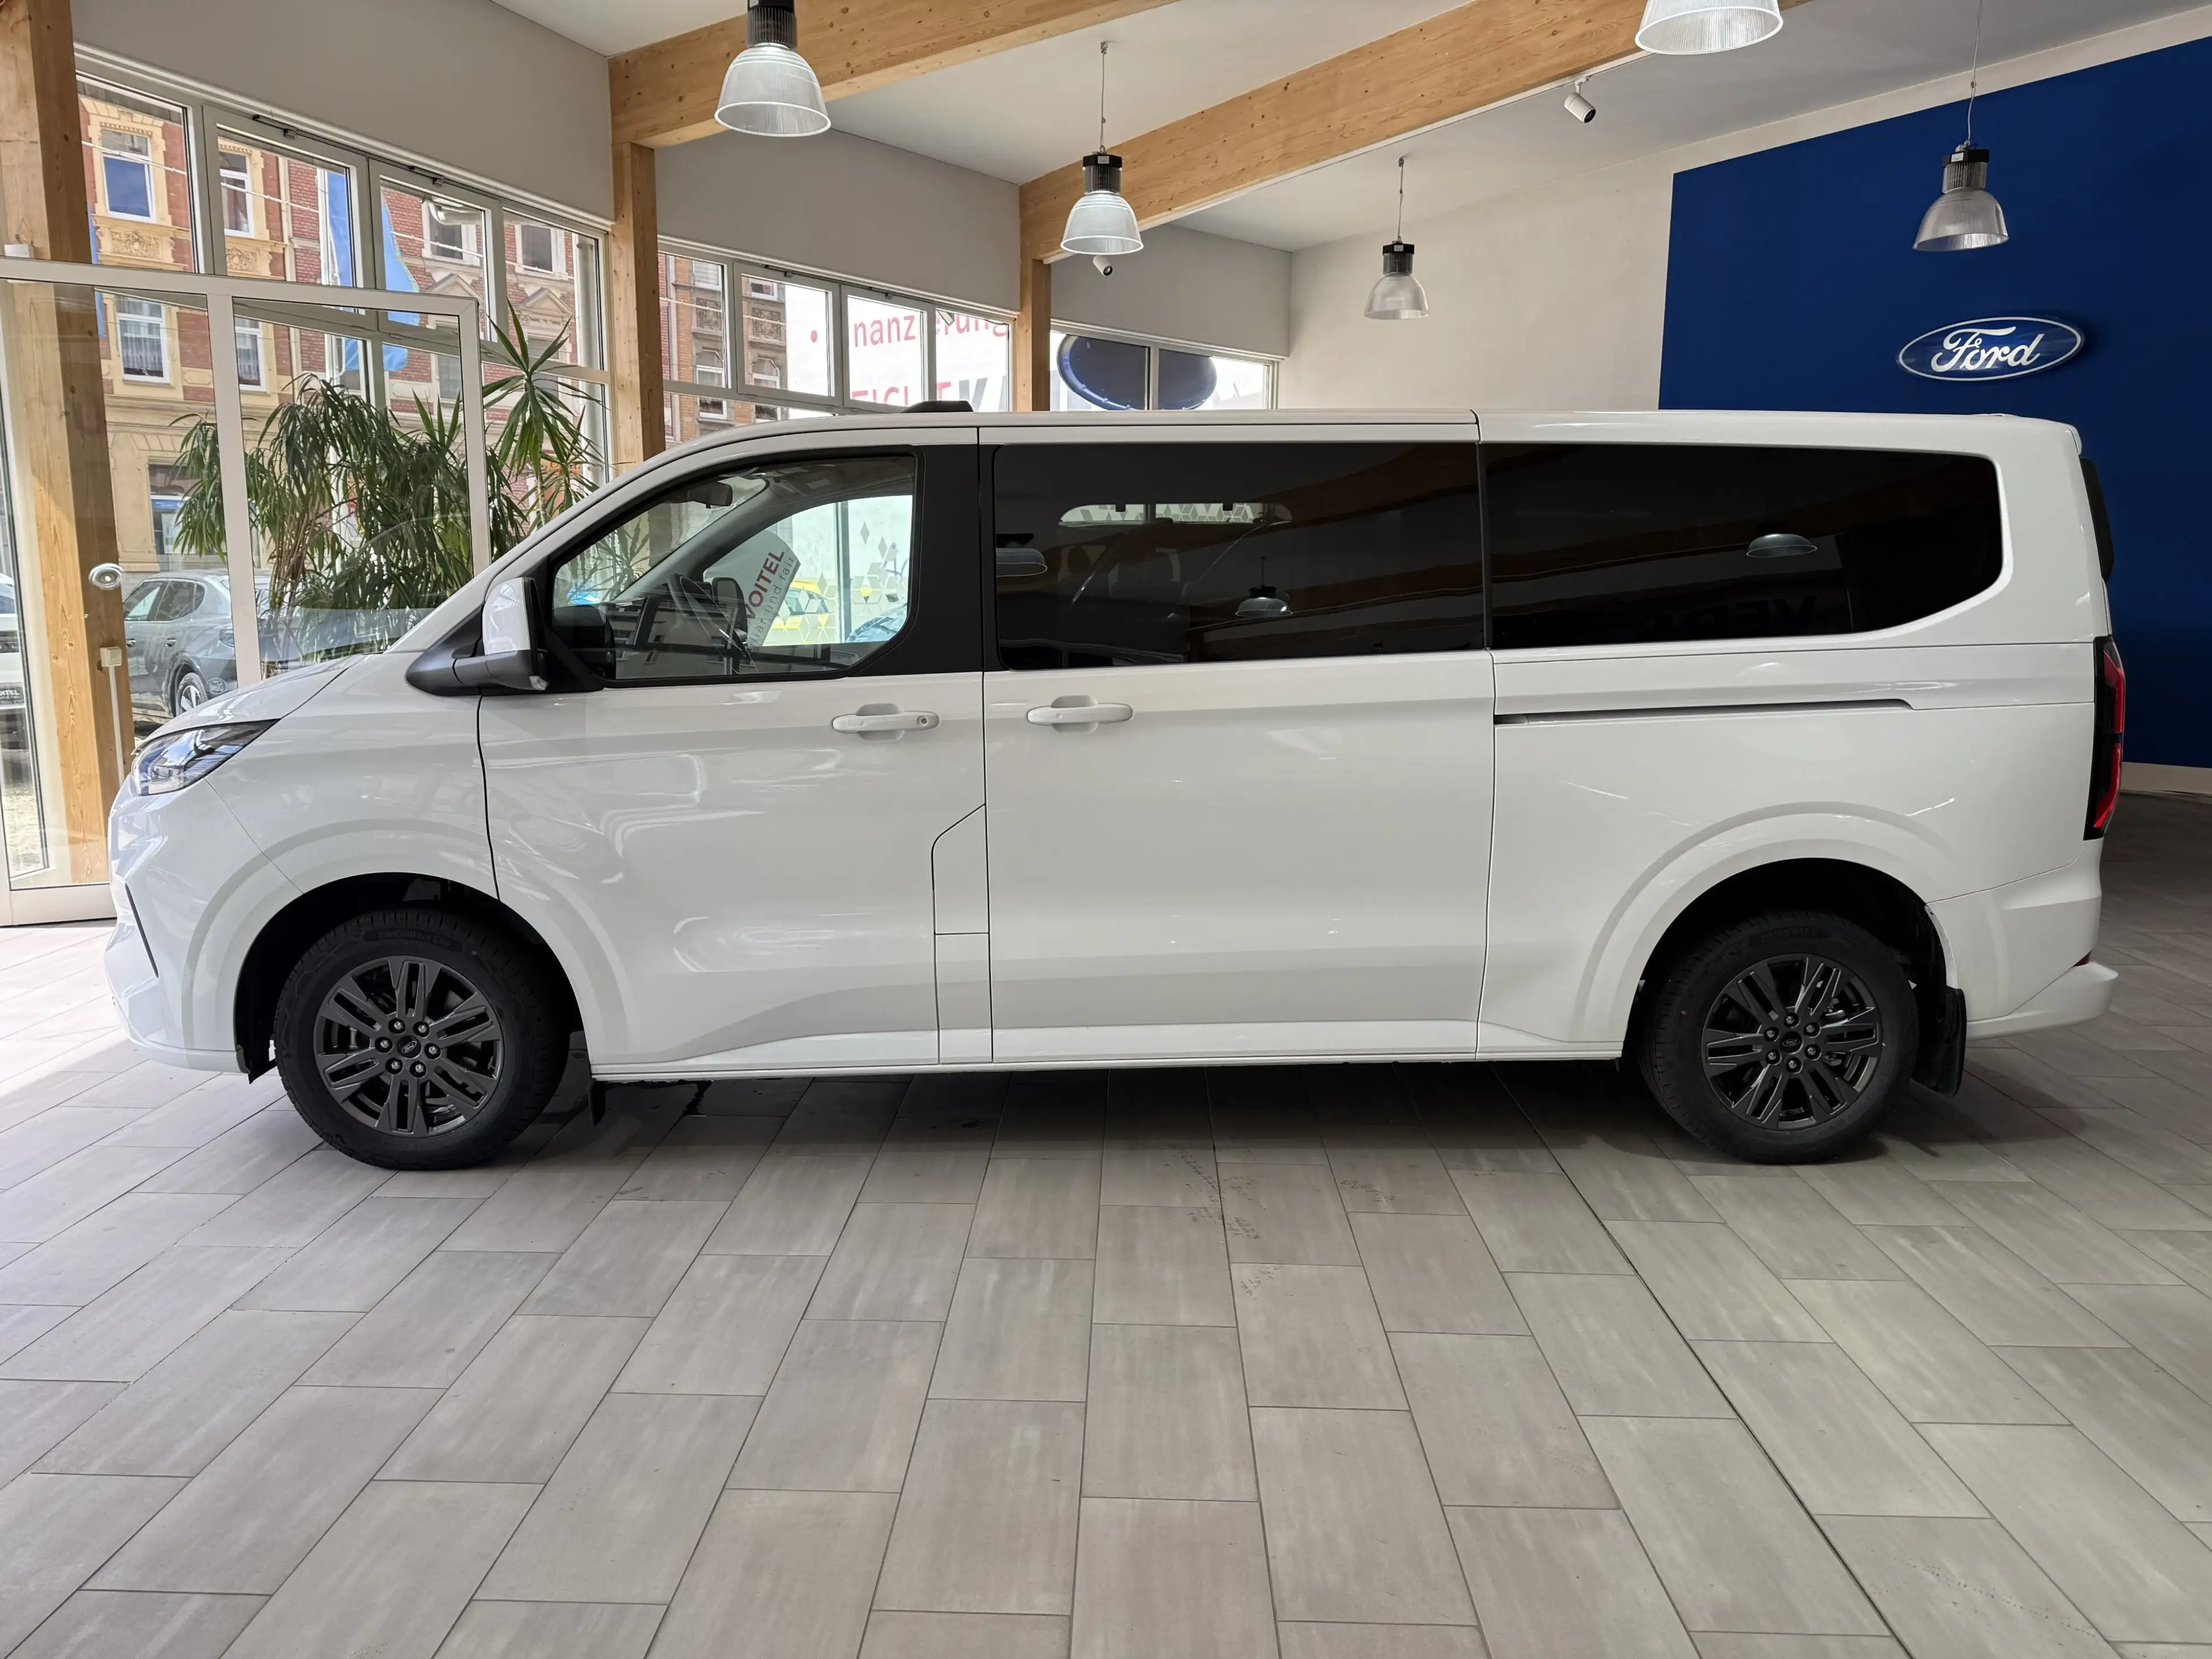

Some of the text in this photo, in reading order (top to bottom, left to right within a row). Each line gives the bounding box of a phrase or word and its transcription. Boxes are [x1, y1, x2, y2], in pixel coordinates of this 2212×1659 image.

[1931, 326, 2044, 372] Ford
[746, 551, 785, 618] VOITEL
[765, 584, 781, 613] und
[778, 556, 795, 581] fair
